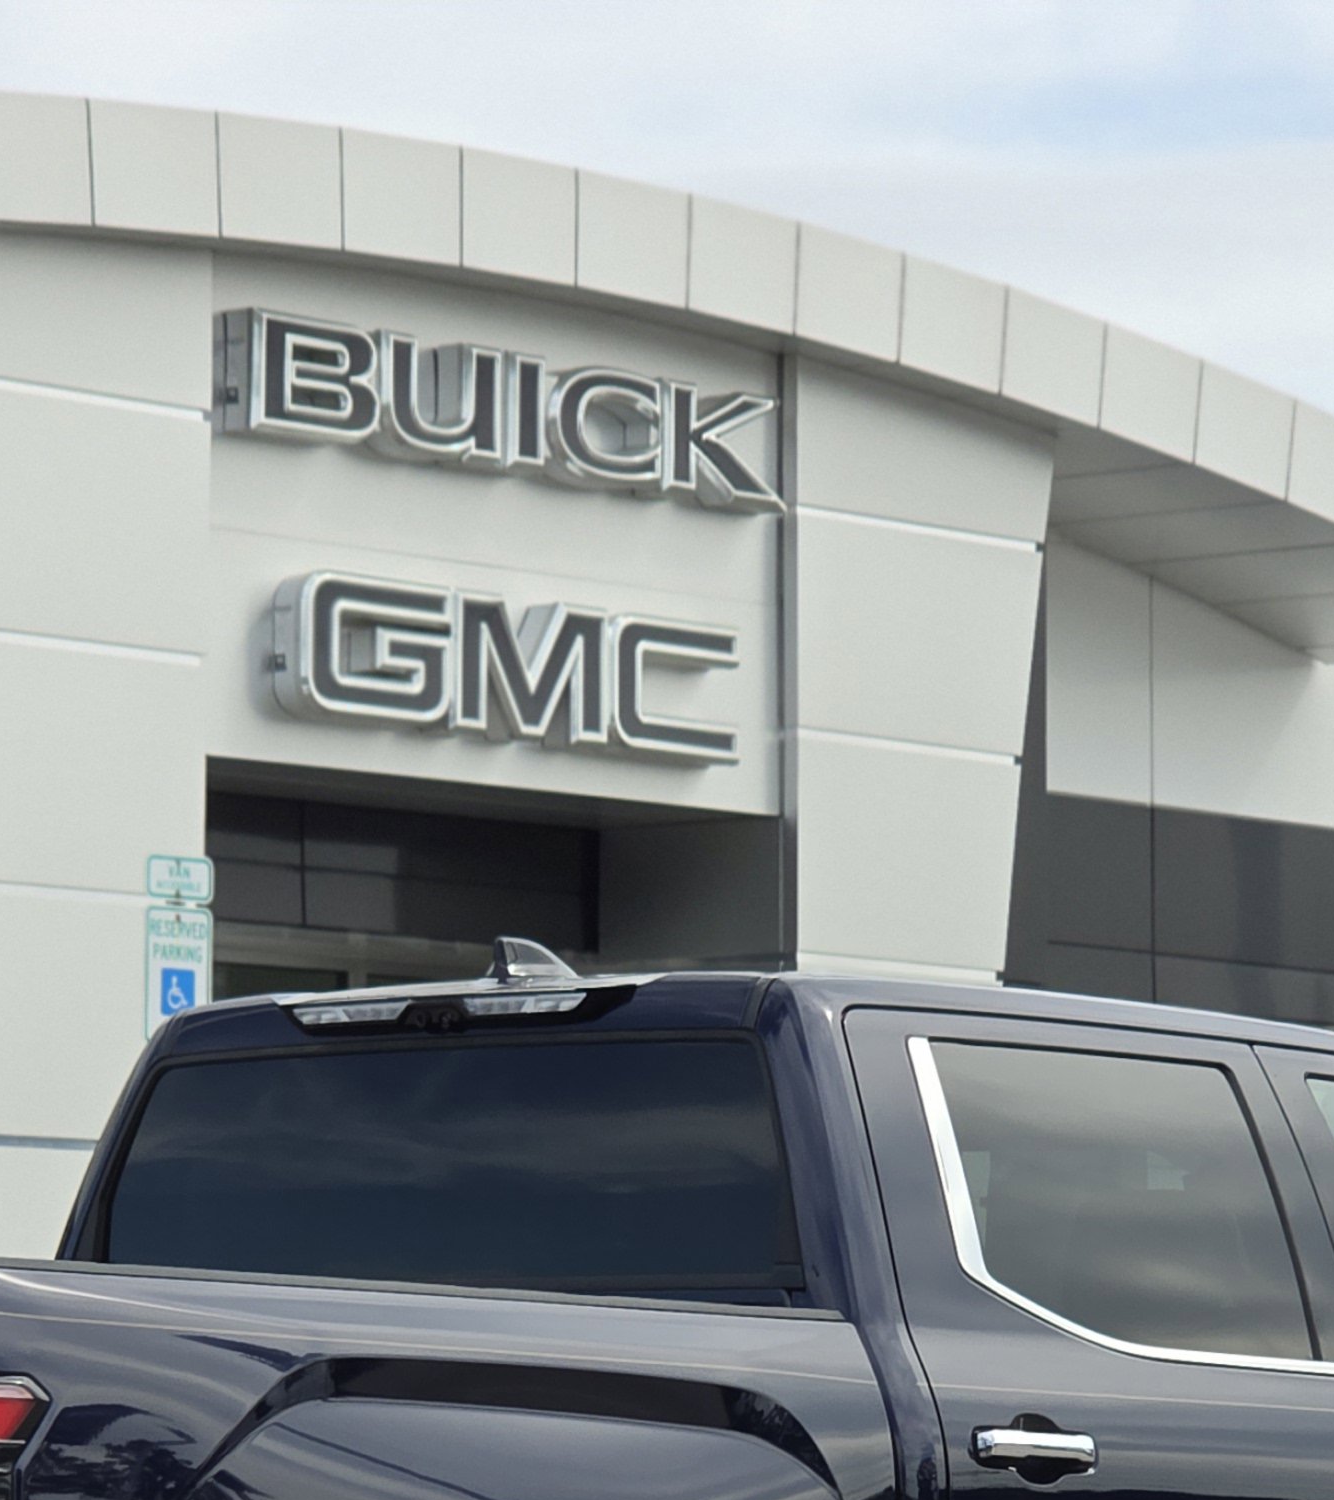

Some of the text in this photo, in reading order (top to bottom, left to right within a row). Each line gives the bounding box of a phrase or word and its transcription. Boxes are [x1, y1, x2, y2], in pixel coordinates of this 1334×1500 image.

[249, 306, 787, 515] BUICK
[299, 570, 739, 766] GMC
[153, 943, 203, 963] PARKING
